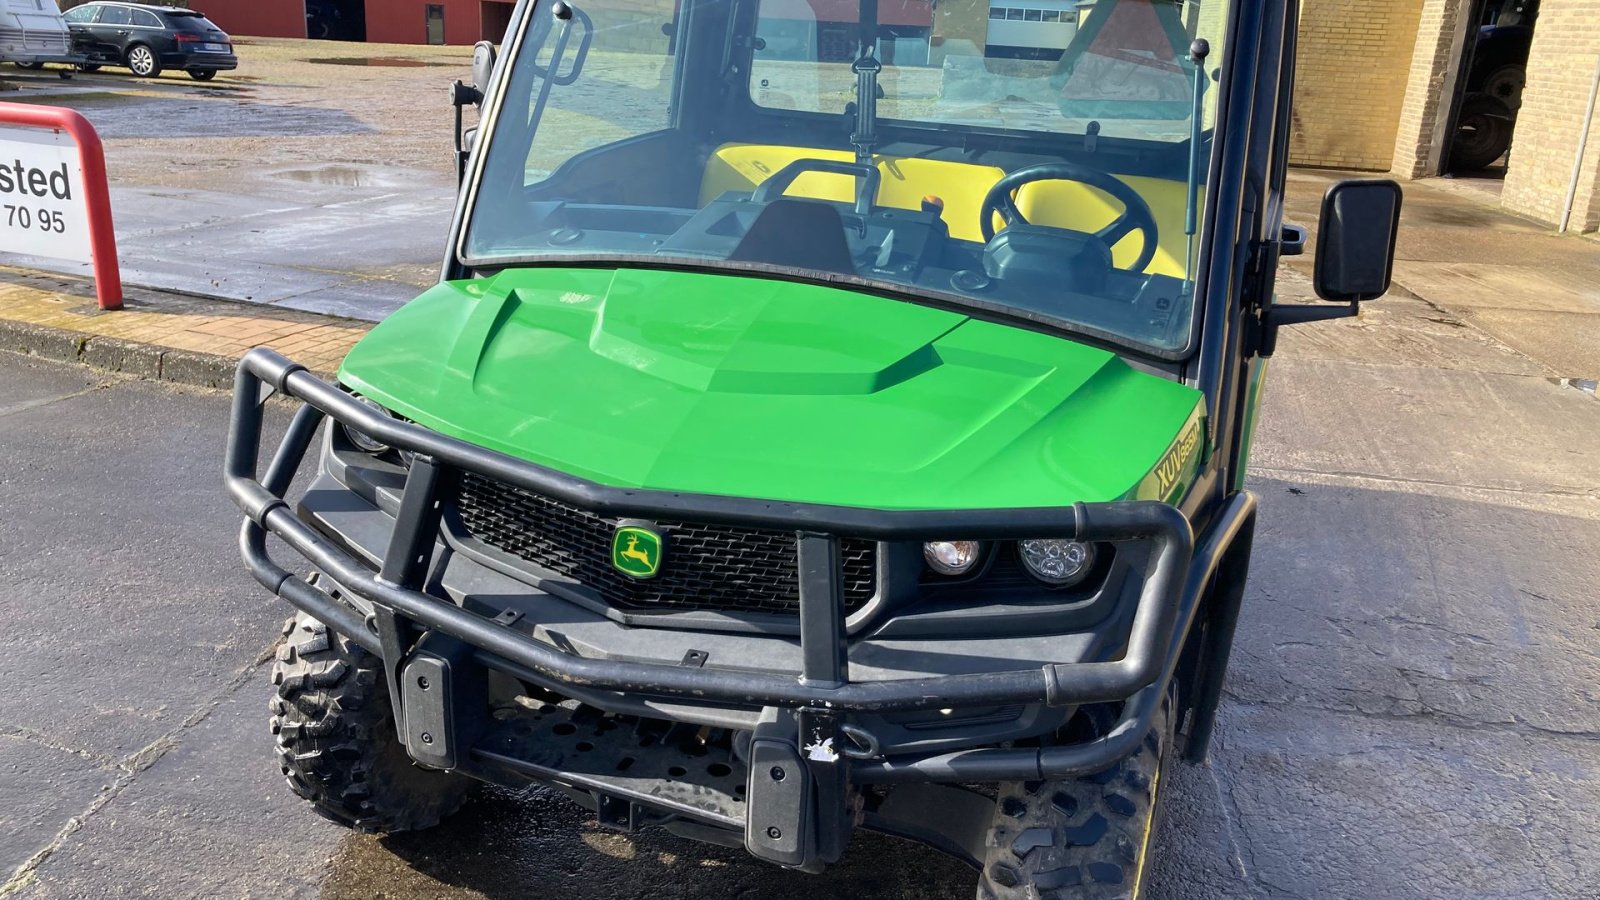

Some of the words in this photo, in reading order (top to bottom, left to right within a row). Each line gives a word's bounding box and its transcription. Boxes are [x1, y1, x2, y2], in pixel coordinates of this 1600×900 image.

[0, 159, 71, 200] sted
[4, 204, 31, 229] 70
[38, 208, 65, 233] 95
